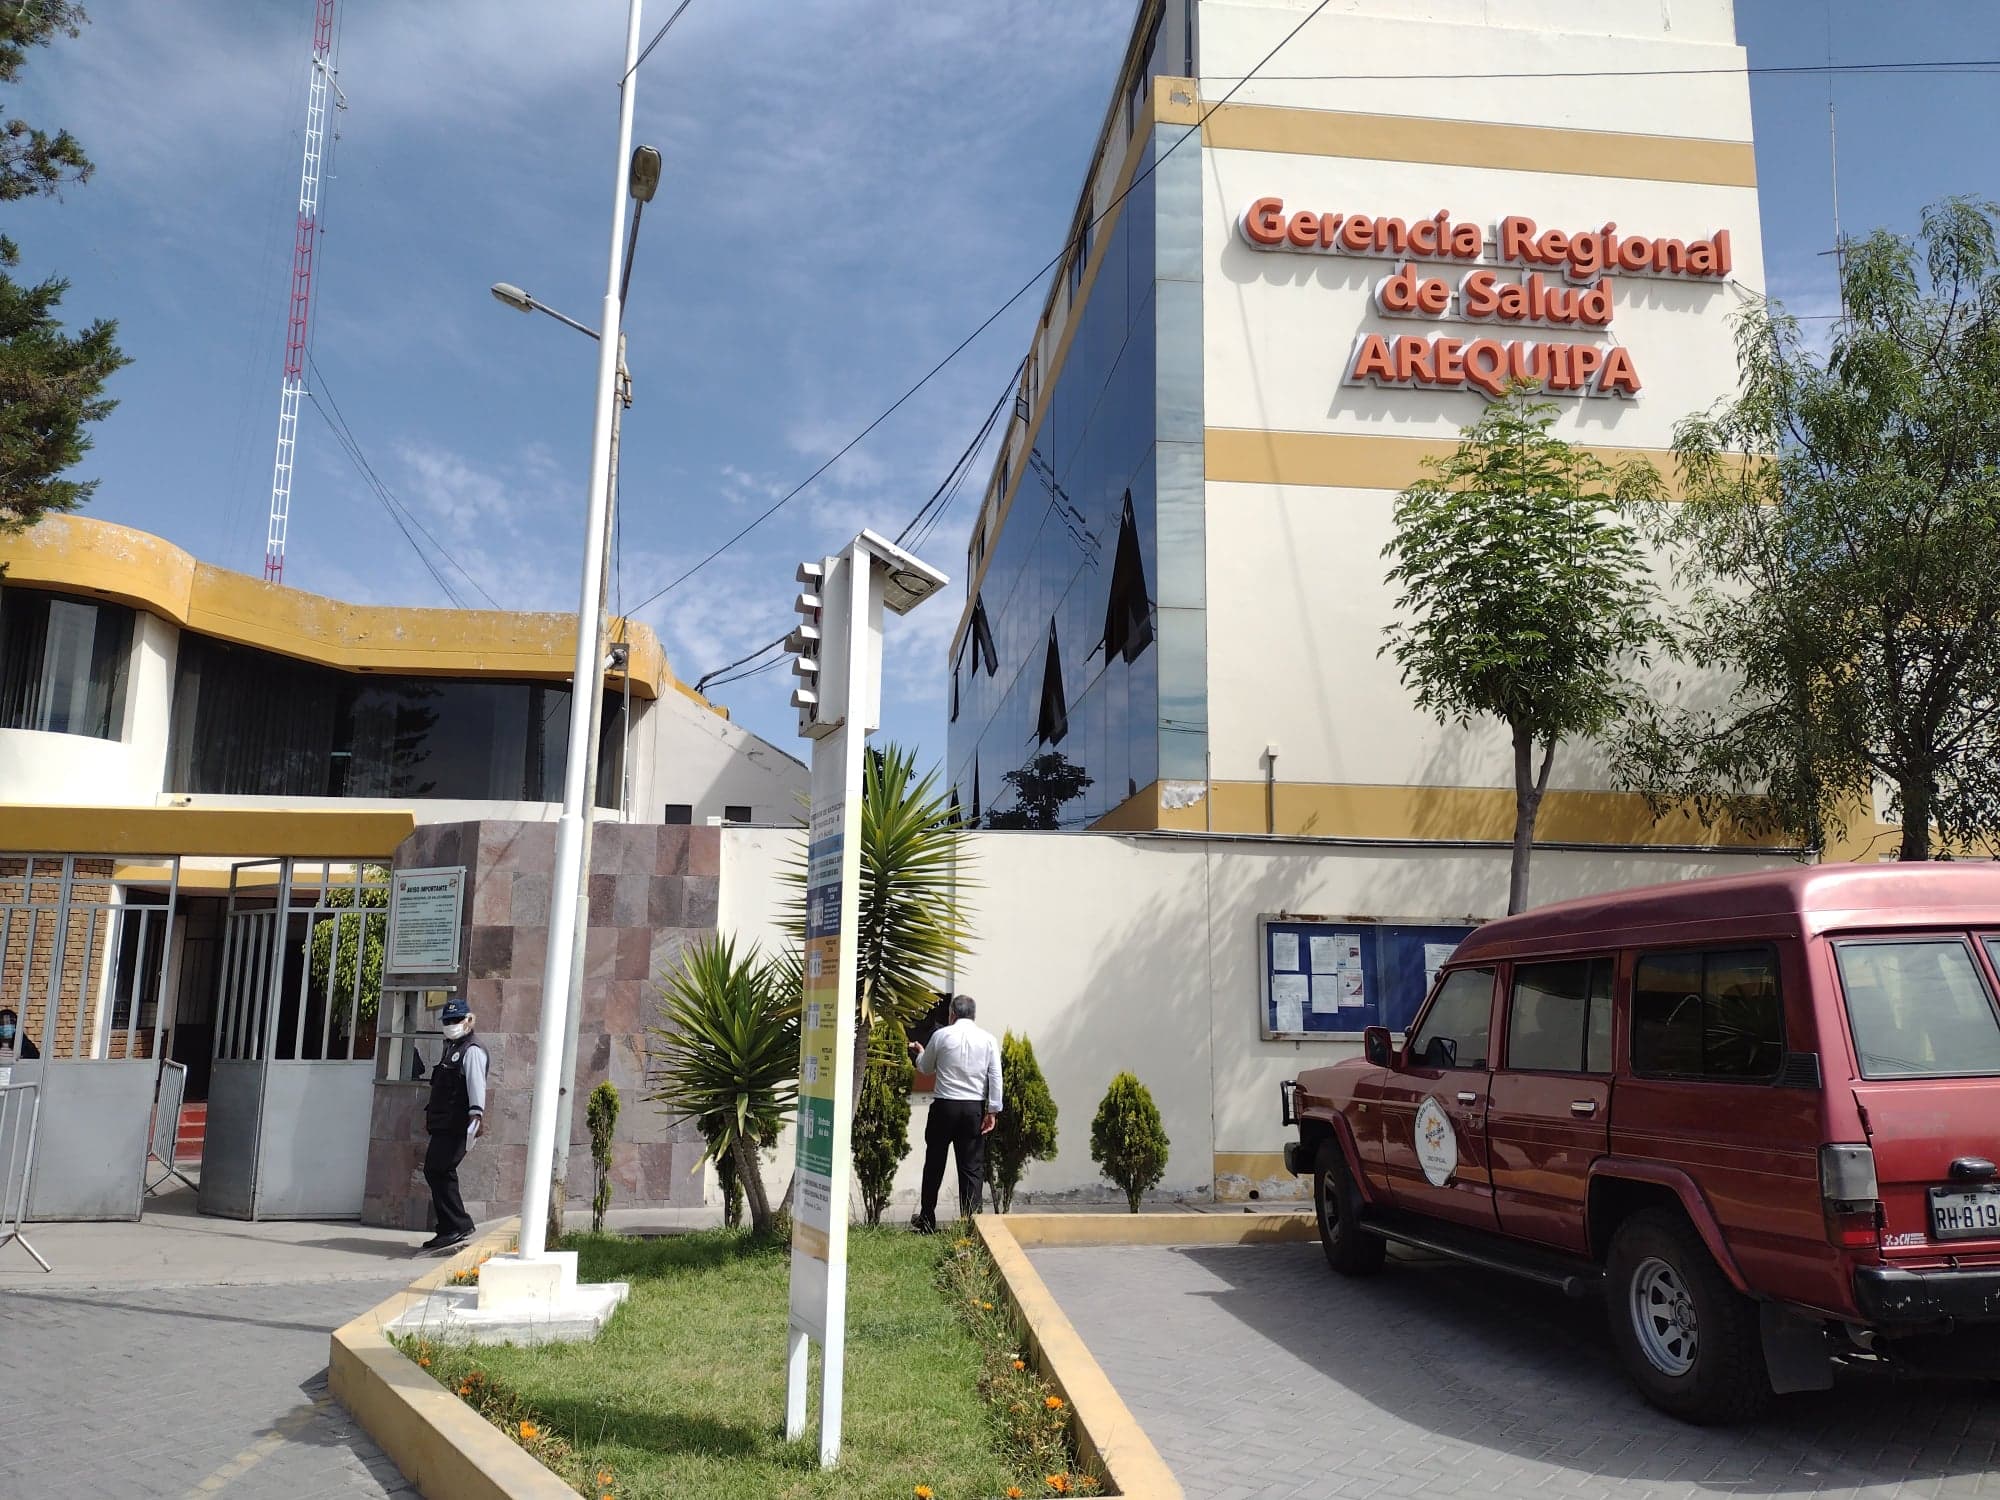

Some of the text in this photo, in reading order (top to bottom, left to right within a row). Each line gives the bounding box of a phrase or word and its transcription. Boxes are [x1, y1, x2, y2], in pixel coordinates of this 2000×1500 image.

[1245, 197, 1732, 278] Gerencia Regional
[1381, 263, 1613, 326] de Salud
[1352, 334, 1642, 396] AREQUIPA
